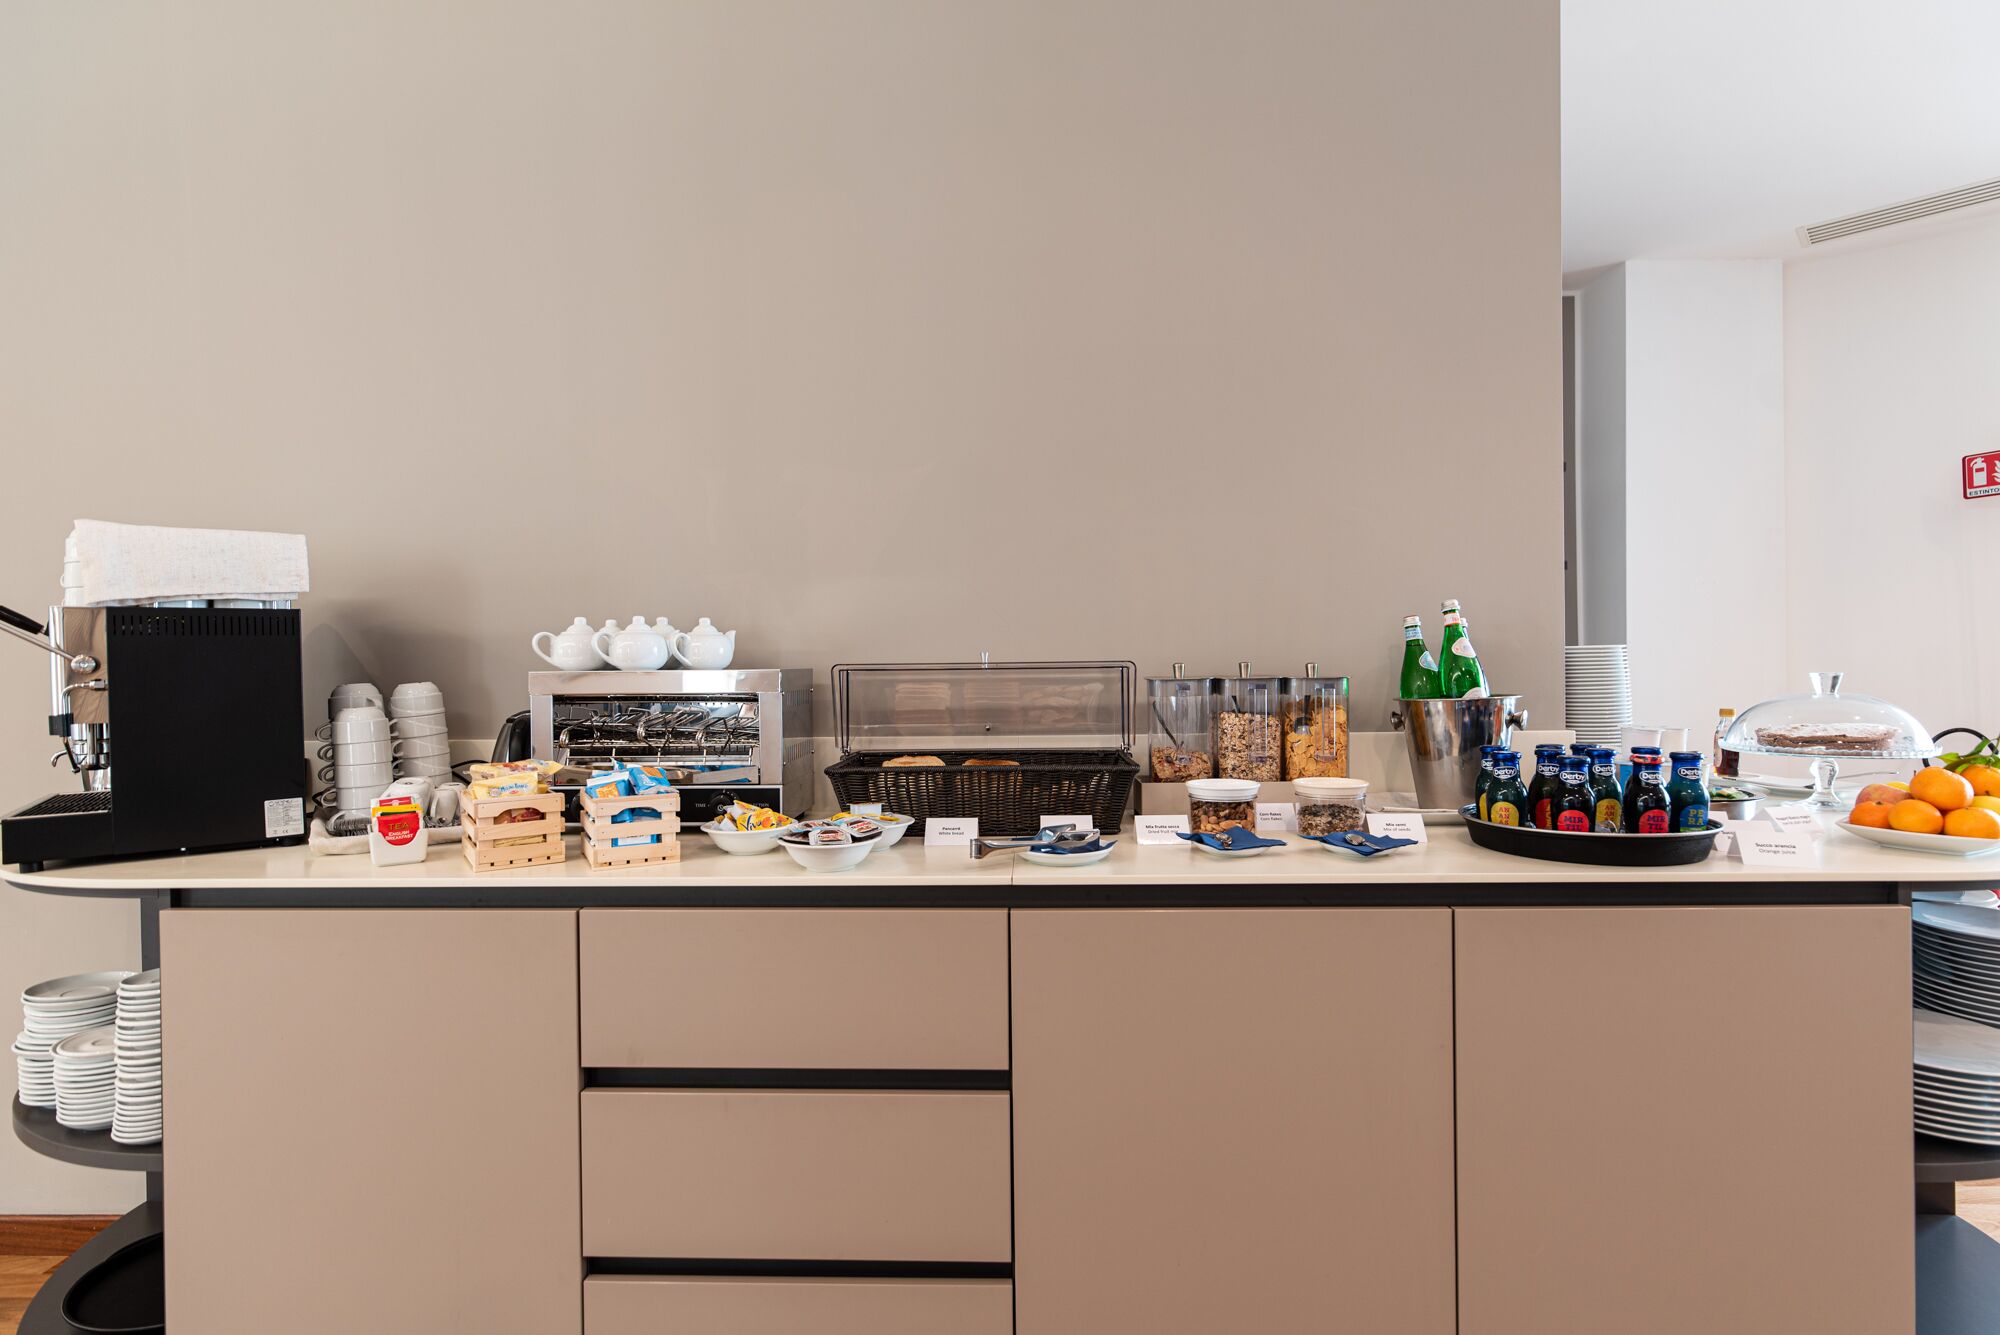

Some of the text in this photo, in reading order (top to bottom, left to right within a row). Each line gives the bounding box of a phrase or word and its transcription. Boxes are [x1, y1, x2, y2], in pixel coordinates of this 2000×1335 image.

[1539, 765, 1559, 773] Derby
[1562, 773, 1585, 781] Derby
[388, 822, 409, 830] TEA
